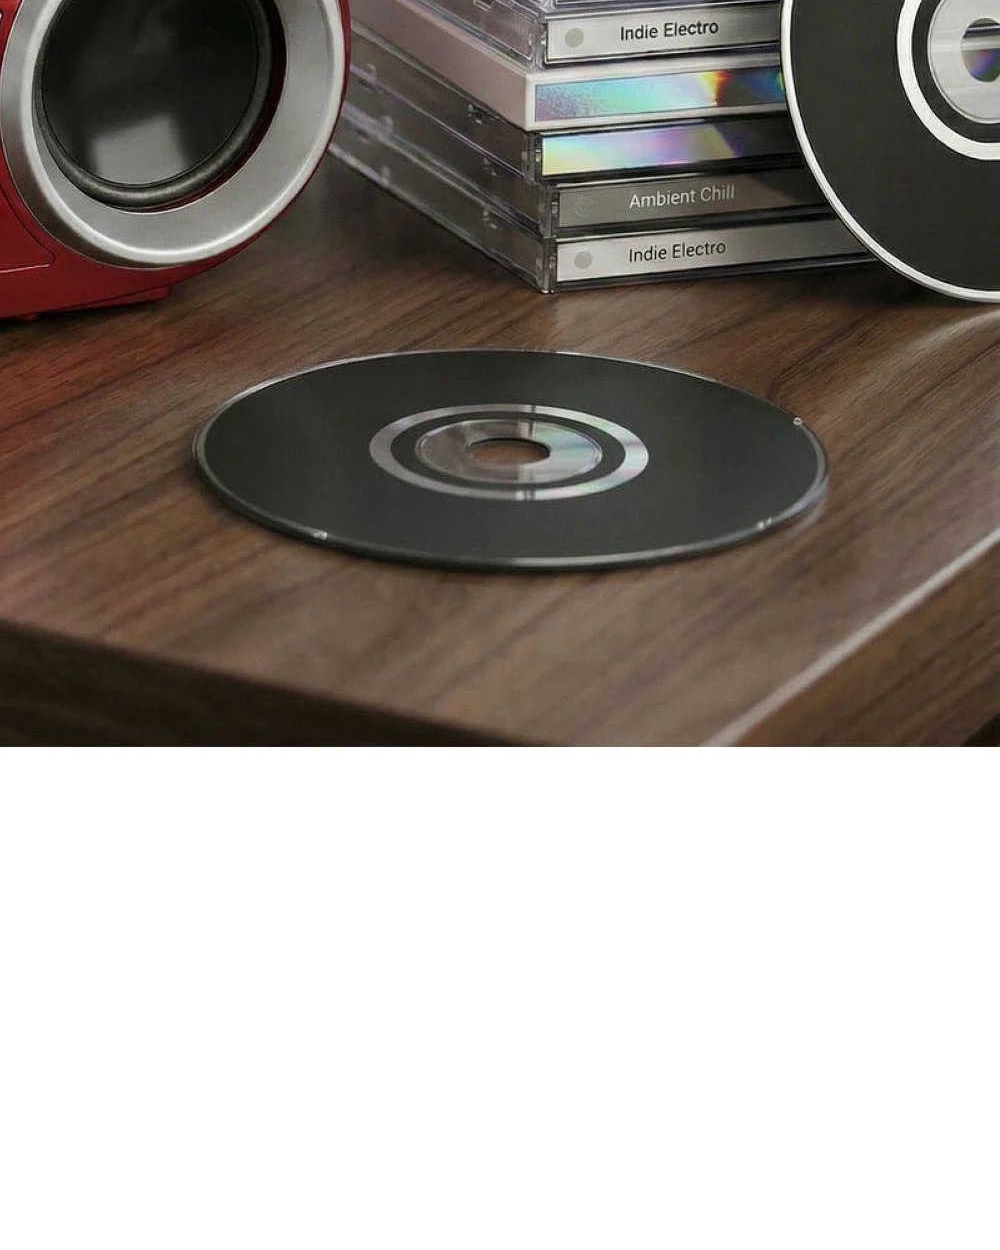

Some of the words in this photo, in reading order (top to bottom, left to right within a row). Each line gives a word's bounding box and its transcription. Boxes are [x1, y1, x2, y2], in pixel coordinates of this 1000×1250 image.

[620, 24, 659, 41] Indie
[663, 20, 719, 38] Electro
[629, 188, 696, 209] Ambient
[700, 184, 735, 202] Chill
[629, 246, 668, 263] Indie
[672, 240, 726, 259] Electro
